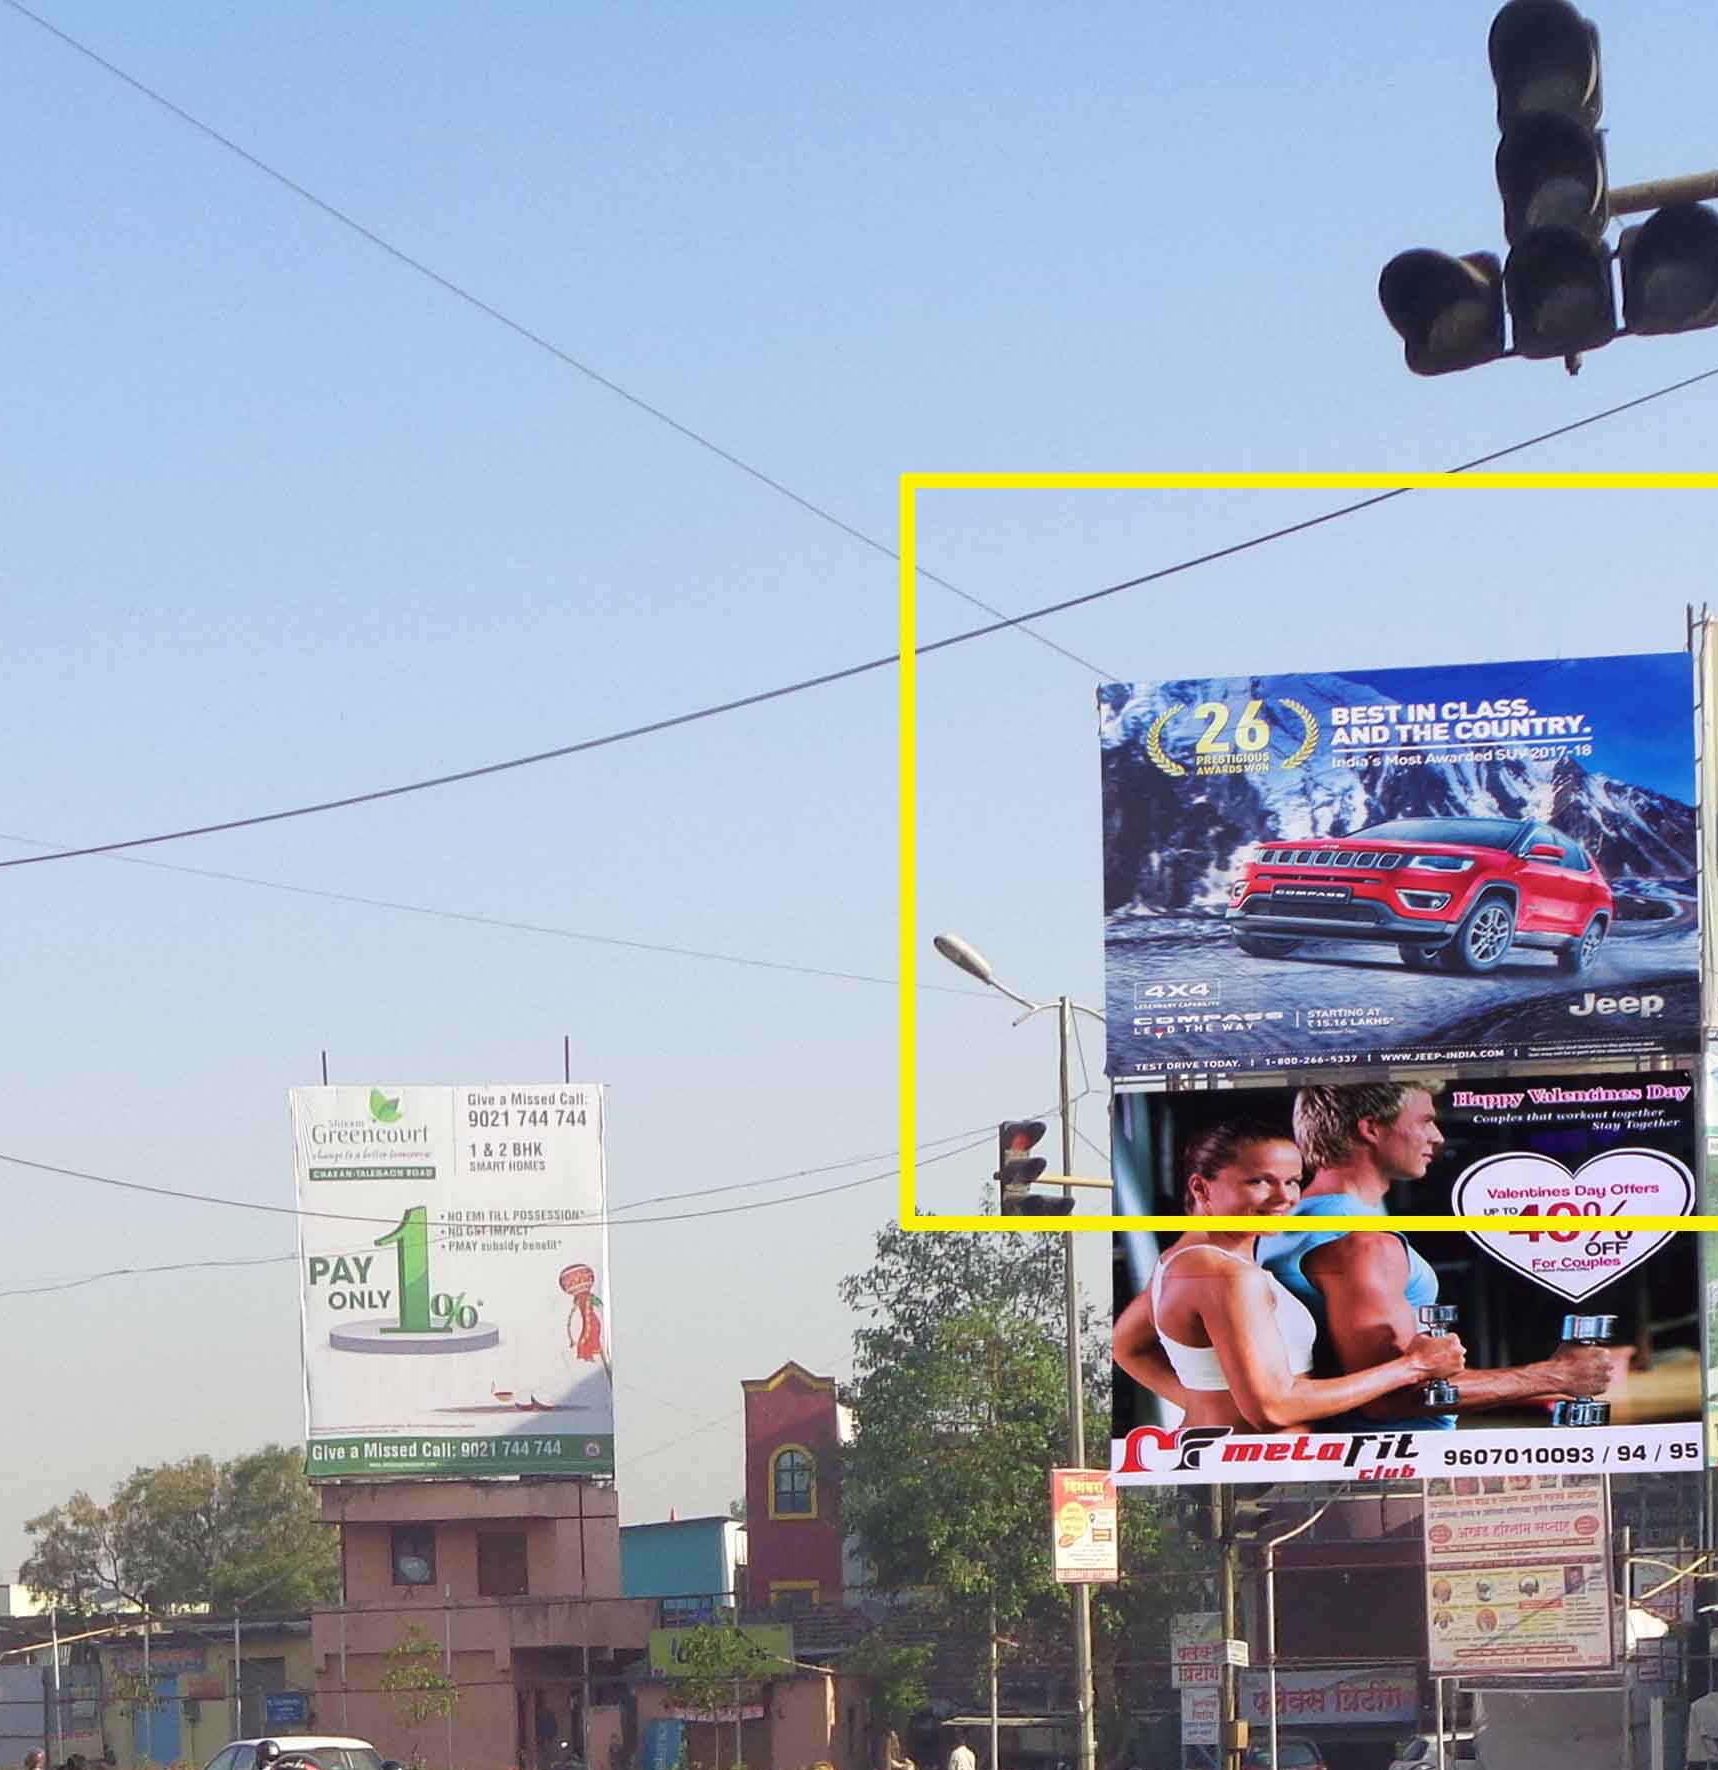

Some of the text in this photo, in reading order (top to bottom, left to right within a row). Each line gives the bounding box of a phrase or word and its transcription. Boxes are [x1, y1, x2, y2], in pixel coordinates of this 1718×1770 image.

[1331, 699, 1537, 726] BEST IN CLASS.
[1195, 700, 1270, 753] 26
[1331, 714, 1593, 745] AND THE COUNTRY.
[1196, 752, 1270, 766] PRESTIGIOUS
[1331, 745, 1592, 768] India's Most Awarded SUV 2017-18
[1196, 763, 1269, 776] AWARDS WON
[1144, 983, 1211, 998] 4X4
[1307, 1007, 1382, 1018] STARTING AT
[1569, 993, 1664, 1017] Jeep
[1134, 1011, 1284, 1026] COMPASS
[1185, 1023, 1205, 1032] THE
[1222, 1022, 1254, 1031] WAY
[1135, 1049, 1505, 1072] TEST DRIVE TODAY. 1-800-266-5337 WWW.JEEP-INDIA.COM
[468, 1093, 495, 1106] Give
[500, 1096, 506, 1105] a
[511, 1092, 556, 1105] Missed
[1452, 1084, 1692, 1110] Happy Valentines Day
[468, 1110, 587, 1127] 9021 744 744
[1473, 1109, 1665, 1125] Couples that workout together
[1591, 1118, 1680, 1132] Stay Together
[312, 1124, 428, 1144] Greencourt
[469, 1142, 543, 1158] 1 & 2 BHK
[470, 1160, 545, 1172] SMART HOMES
[1487, 1183, 1660, 1200] Valentines Day Offers
[447, 1211, 462, 1222] NO
[466, 1210, 485, 1221] EMI
[488, 1210, 509, 1221] TILL
[1483, 1206, 1518, 1216] UP TO
[448, 1226, 462, 1237] NO
[448, 1241, 478, 1252] PMAY
[481, 1240, 519, 1253] subsidy
[1585, 1241, 1628, 1257] OFF
[309, 1255, 373, 1286] PAY
[1532, 1256, 1621, 1270] For Couples
[328, 1290, 392, 1310] ONLY
[312, 1440, 562, 1462] Give a Missed Call: 9021 744 744
[1443, 1441, 1699, 1467] 9607010093 94 95
[1358, 1462, 1416, 1479] club
